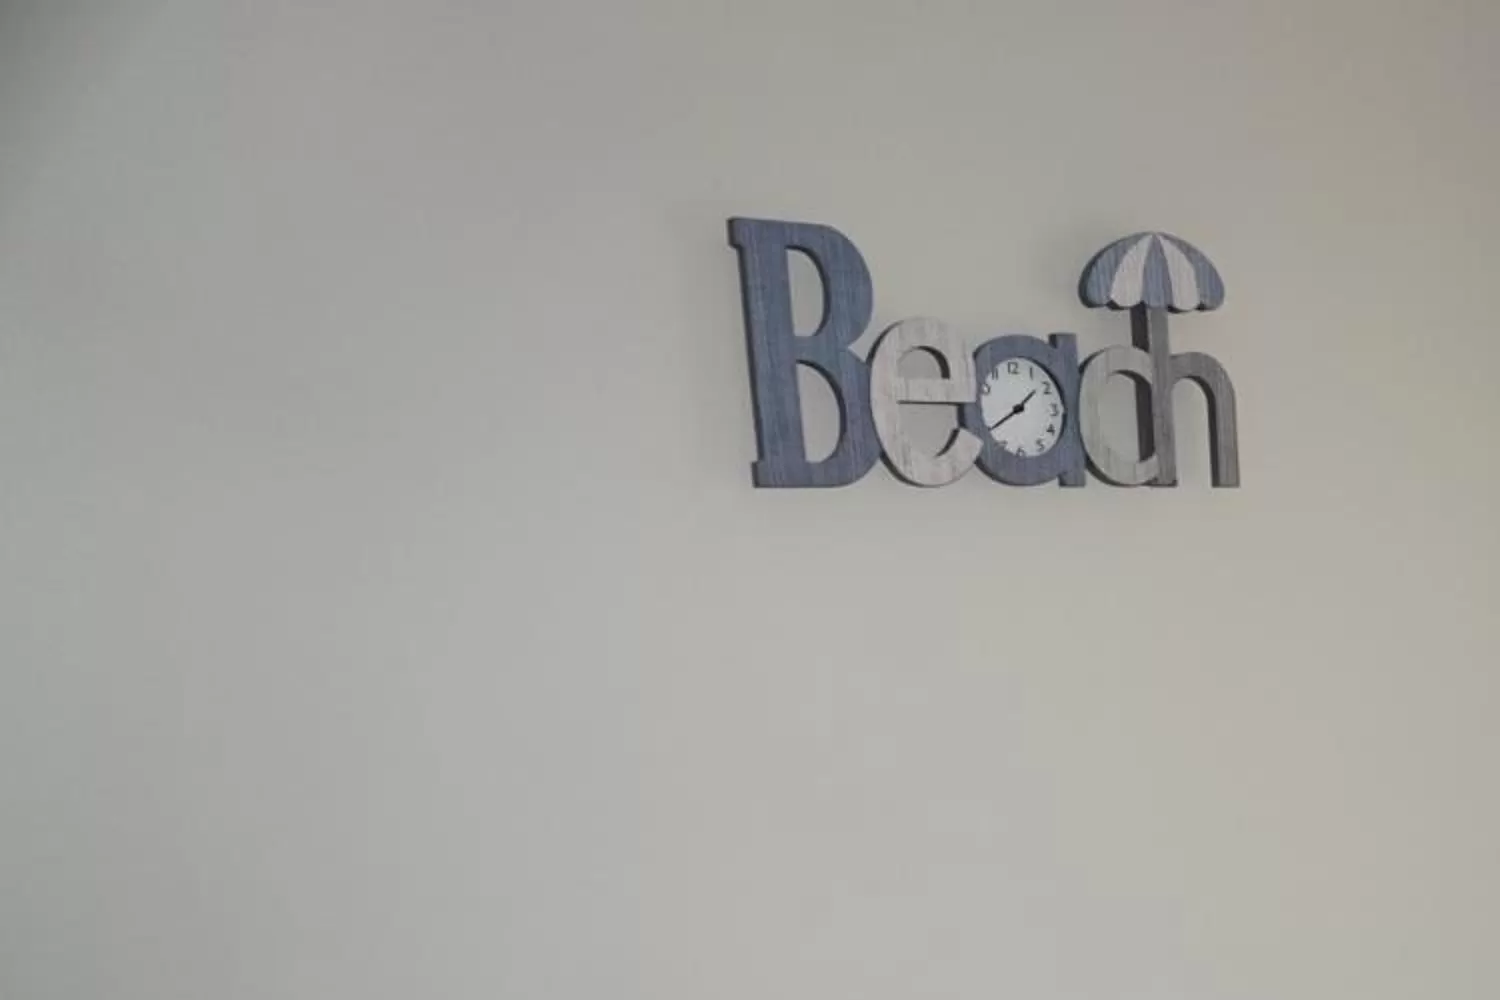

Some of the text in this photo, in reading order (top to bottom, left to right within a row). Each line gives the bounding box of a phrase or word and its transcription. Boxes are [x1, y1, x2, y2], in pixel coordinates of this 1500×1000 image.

[727, 217, 1241, 488] Beach
[1007, 361, 1020, 375] 12
[1029, 366, 1034, 380] 1
[1042, 381, 1053, 395] 2
[1049, 403, 1059, 417] 3
[1045, 424, 1056, 436] 4
